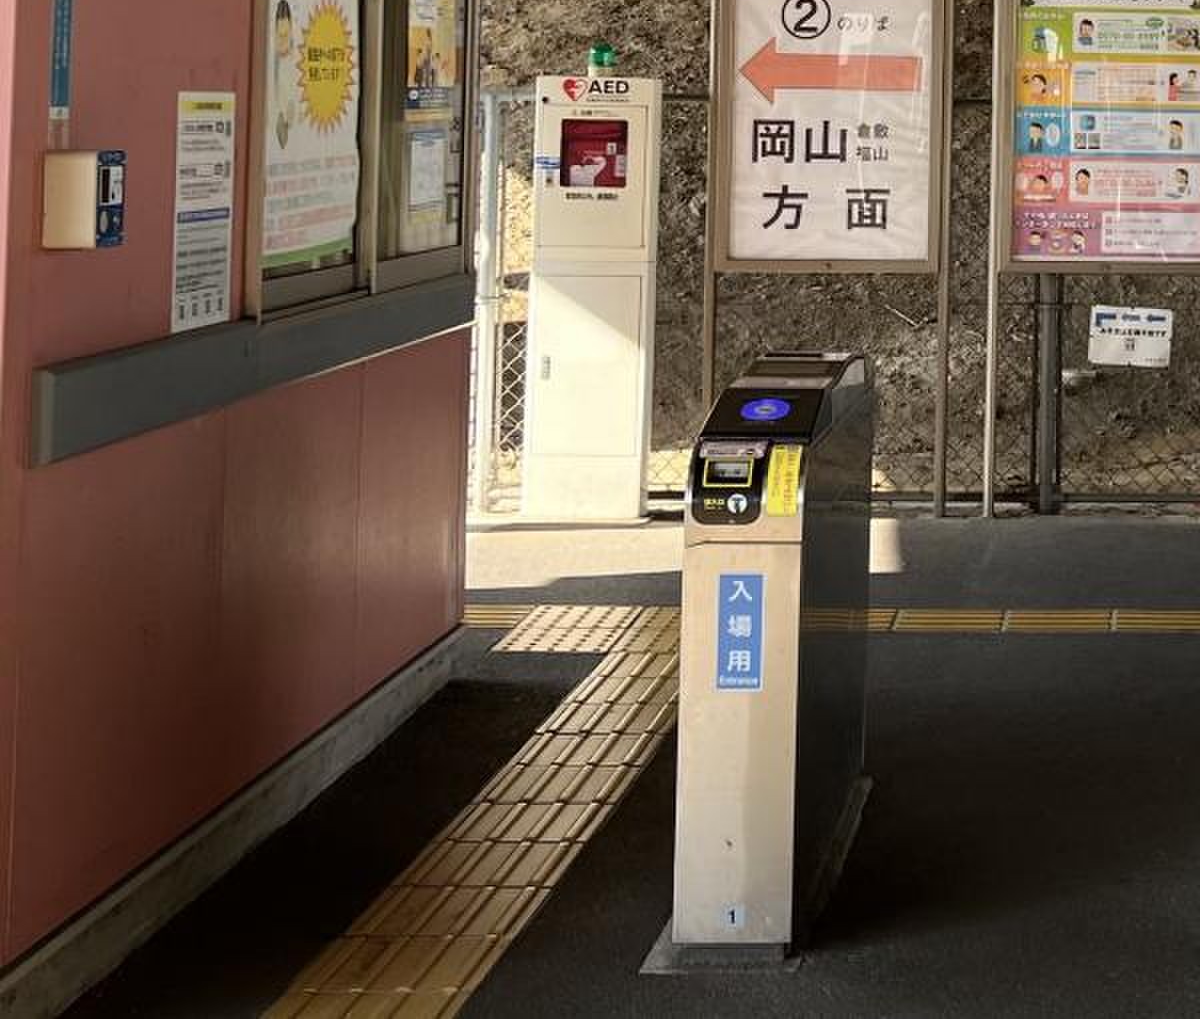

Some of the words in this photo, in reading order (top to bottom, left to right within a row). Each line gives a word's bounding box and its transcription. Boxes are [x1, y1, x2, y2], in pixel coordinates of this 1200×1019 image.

[588, 80, 630, 94] AED
[752, 119, 848, 163] 岡山
[856, 146, 889, 162] 福山
[727, 580, 753, 672] 入場用
[727, 909, 736, 925] 1
